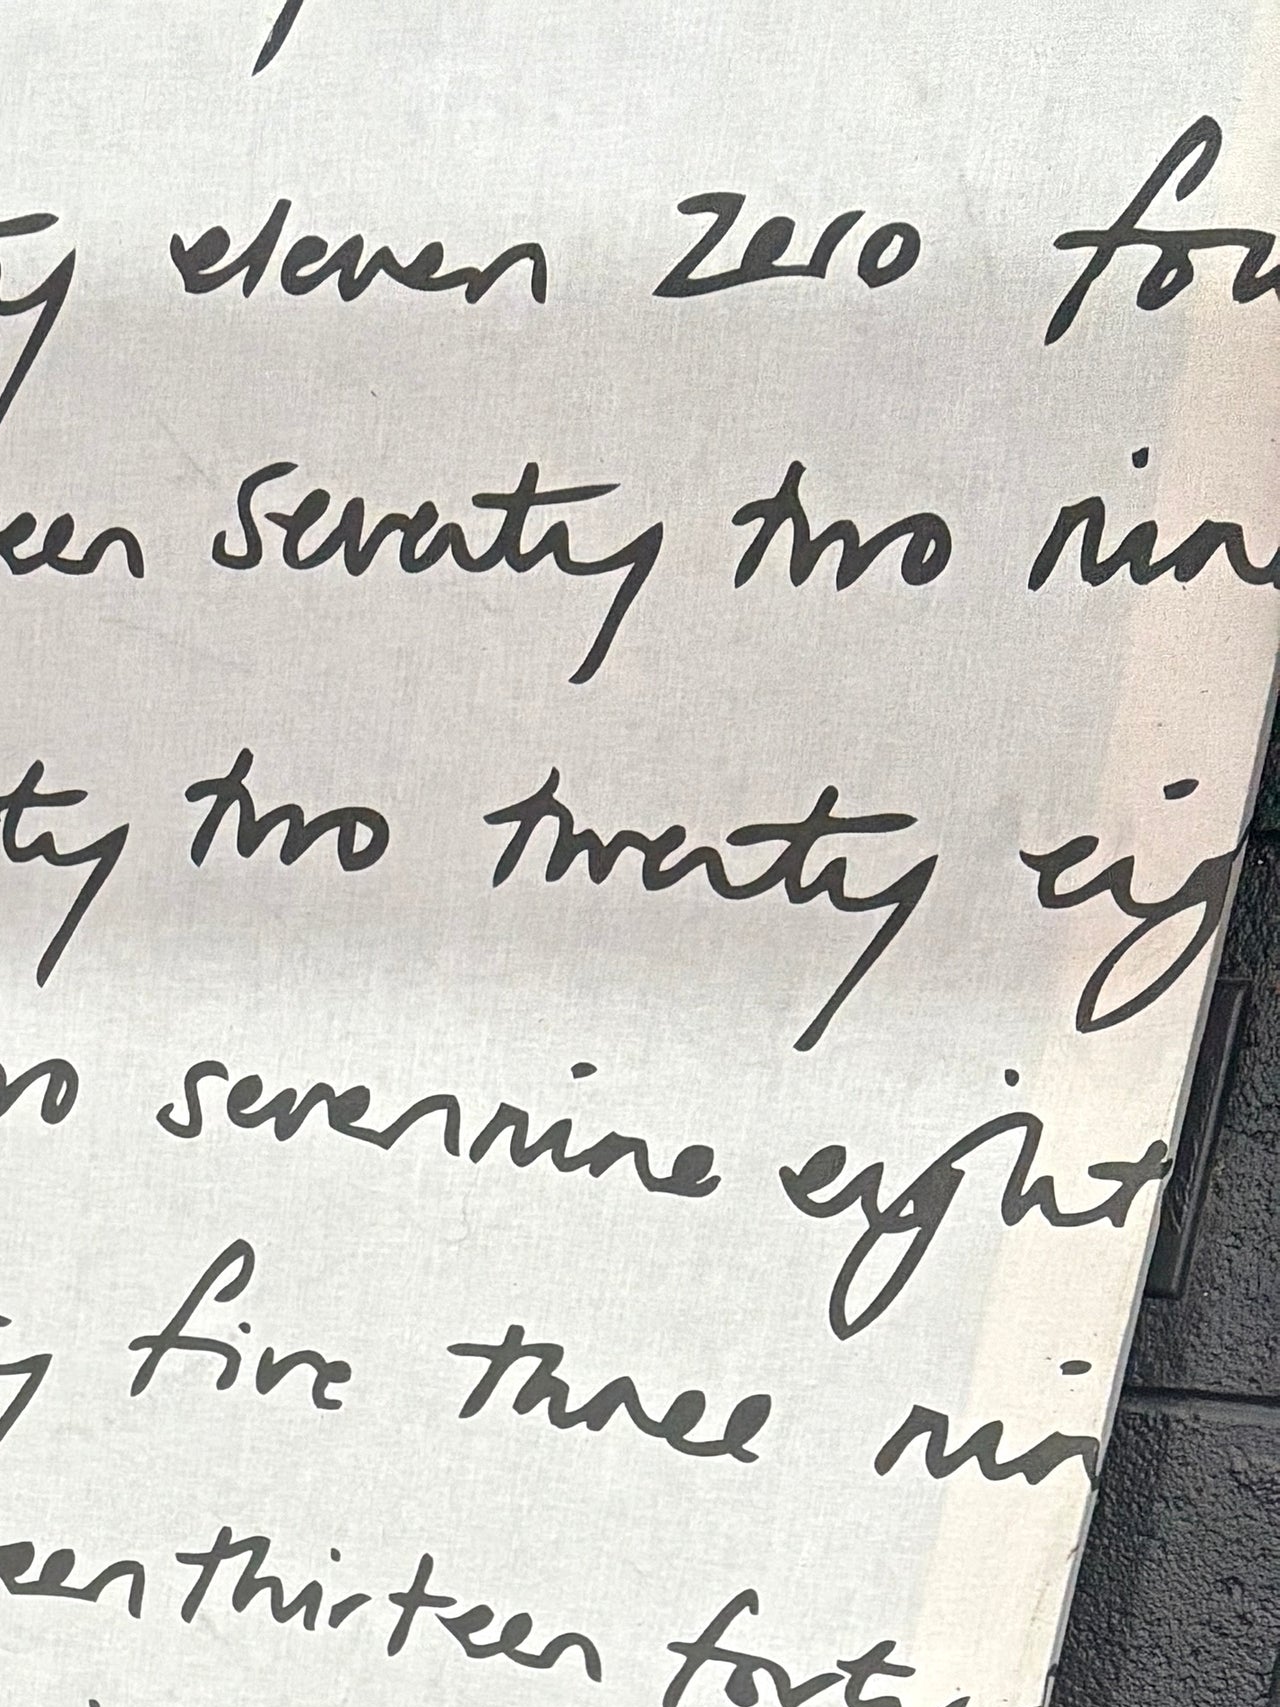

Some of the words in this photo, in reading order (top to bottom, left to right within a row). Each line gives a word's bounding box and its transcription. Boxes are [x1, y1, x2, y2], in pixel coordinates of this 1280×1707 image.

[168, 197, 549, 306] eleven
[651, 190, 922, 300] zero
[730, 459, 953, 593] two
[1026, 445, 1280, 593] nin
[183, 746, 391, 873] two
[482, 765, 940, 1053] twenty
[777, 1067, 1172, 1342] eight
[127, 1237, 353, 1411] five
[445, 1323, 773, 1464] three
[174, 1525, 603, 1684] thirteen
